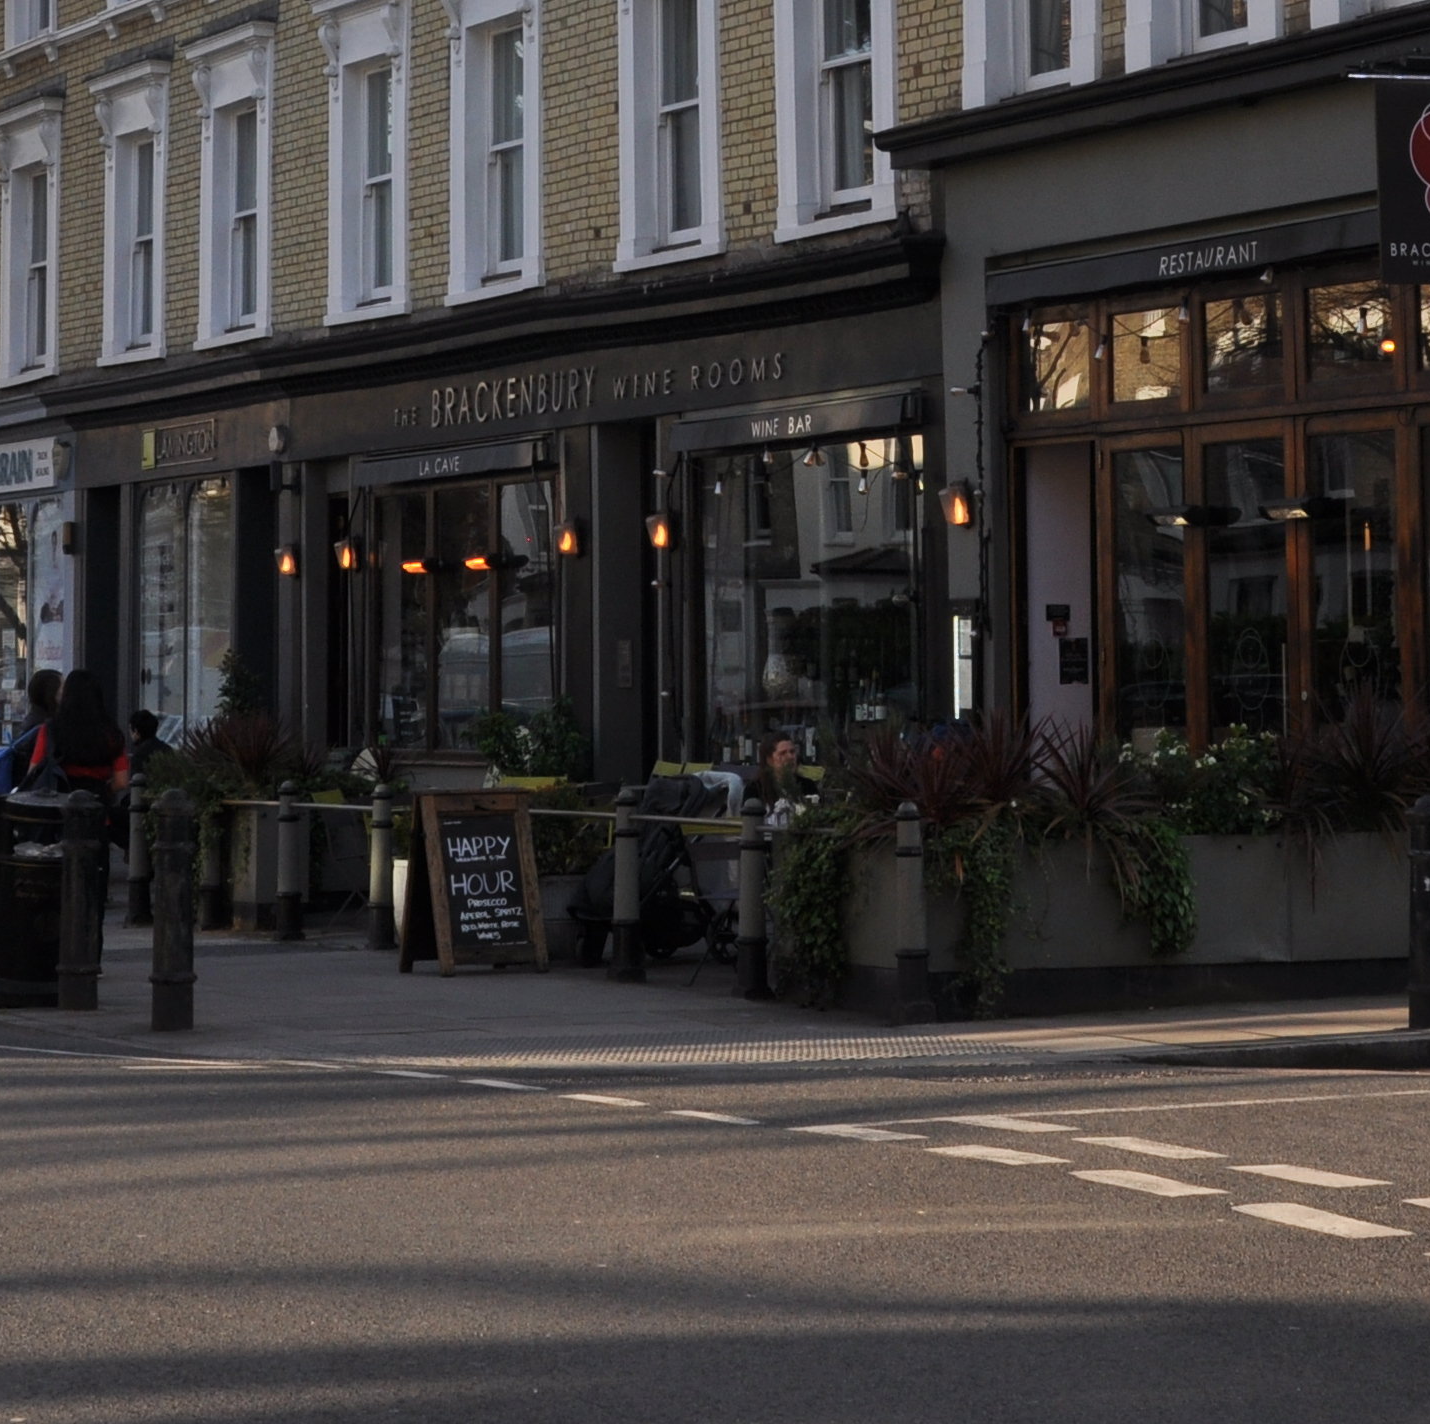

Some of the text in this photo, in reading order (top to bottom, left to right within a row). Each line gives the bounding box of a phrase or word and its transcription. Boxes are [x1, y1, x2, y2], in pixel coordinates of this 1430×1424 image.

[1158, 240, 1258, 277] RESTAURANT
[394, 352, 783, 428] THE BRACKENBURY WINE ROOMS
[751, 414, 812, 438] WINE BAR
[419, 456, 460, 476] LA CAVE
[447, 835, 510, 858] HAPPY
[450, 870, 517, 896] HOUR
[467, 897, 508, 909] PROSECCO
